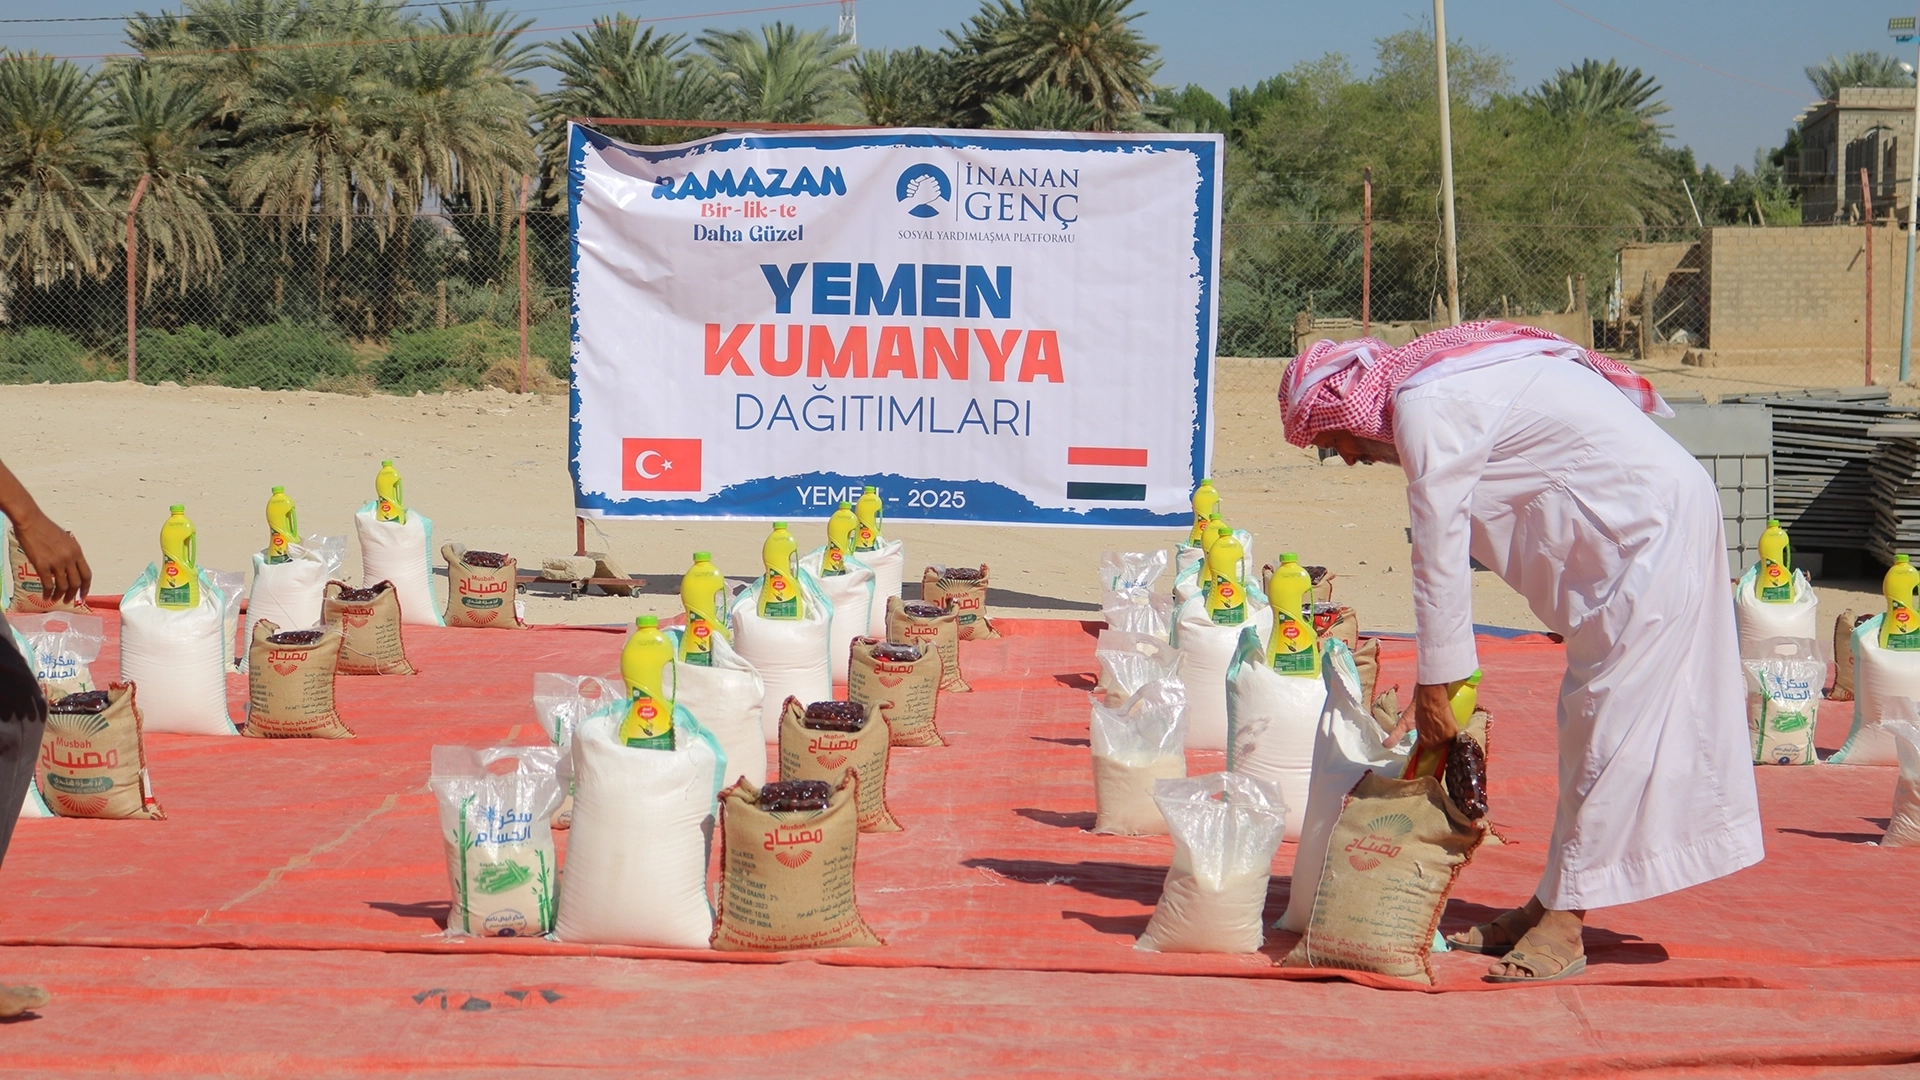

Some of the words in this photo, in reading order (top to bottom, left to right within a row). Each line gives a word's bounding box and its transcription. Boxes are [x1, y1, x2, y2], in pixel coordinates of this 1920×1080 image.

[651, 165, 847, 201] RAMAZAN
[965, 162, 1079, 188] İNANAN
[701, 201, 797, 218] Bir-lik-te
[964, 191, 1079, 230] GENÇ
[693, 224, 743, 242] Daha
[750, 224, 803, 242] Güzel
[898, 230, 934, 240] SOSYAL
[937, 231, 1011, 243] YARDIMLAŞMA
[1013, 233, 1075, 243] PLATFORMU
[759, 262, 1012, 319] YEMEN
[704, 323, 1065, 383] KUMANYA
[735, 384, 1031, 437] DAĞITIMLARI
[908, 489, 966, 509] 2025
[459, 578, 508, 597] مصباح
[904, 625, 938, 638] مصباح
[53, 655, 76, 669] سكر
[268, 650, 308, 663] مصباح
[873, 662, 914, 676] مصباح
[1785, 679, 1809, 690] سكر
[56, 736, 92, 748] Musbah
[808, 737, 858, 754] مصباح
[42, 741, 119, 775] مصباح
[498, 808, 532, 830] سكر
[475, 825, 531, 847] الحسام
[764, 829, 822, 851] مصباح
[1344, 836, 1402, 858] مصباح
